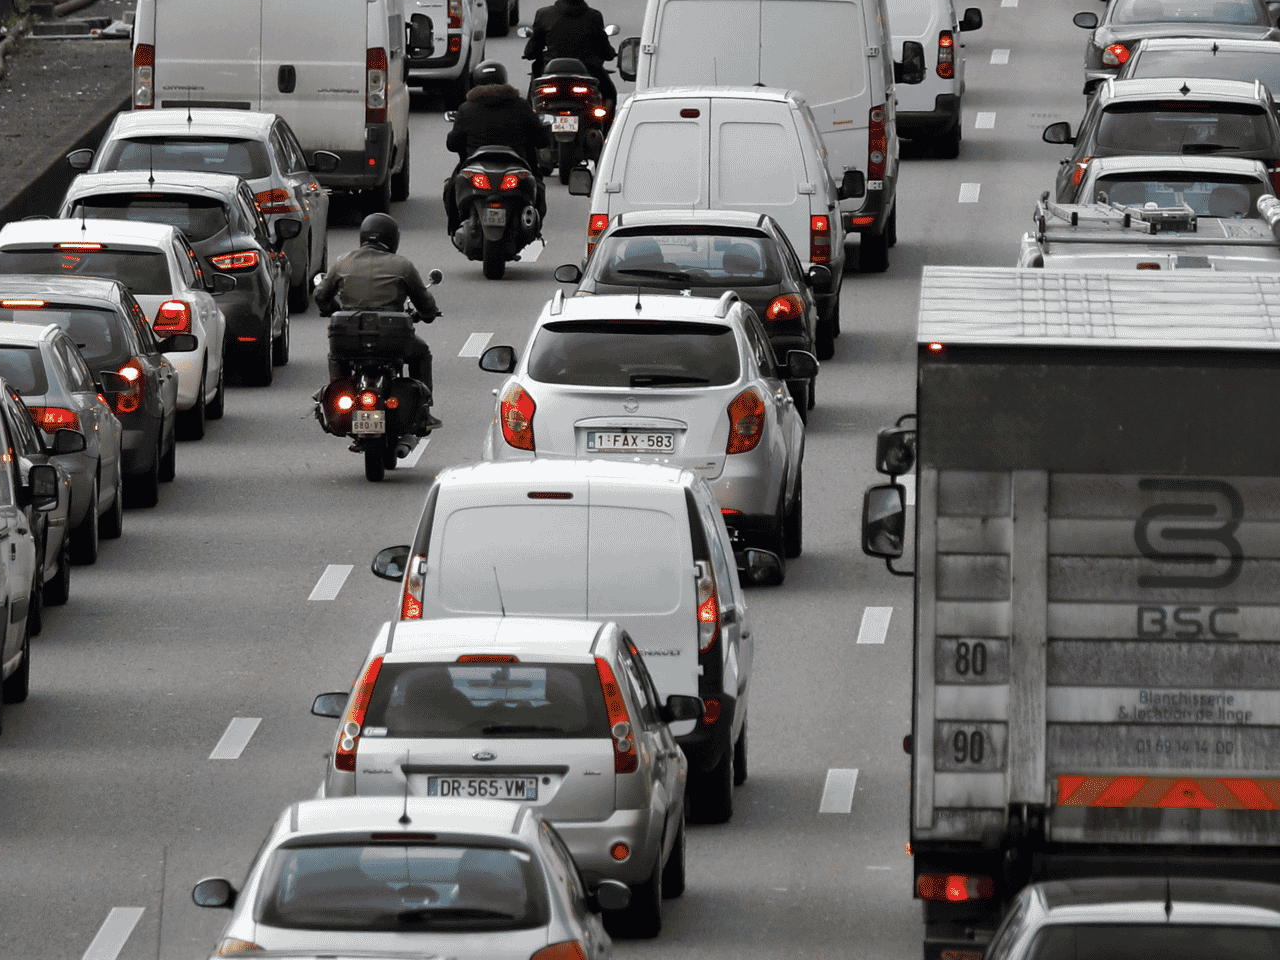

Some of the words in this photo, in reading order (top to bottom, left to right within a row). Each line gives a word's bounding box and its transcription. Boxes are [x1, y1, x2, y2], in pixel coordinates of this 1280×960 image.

[1136, 606, 1241, 639] BSC
[955, 640, 987, 677] 80
[1138, 690, 1235, 705] Blanchisserie
[1133, 706, 1192, 721] location
[1195, 707, 1213, 721] de
[1218, 707, 1253, 725] linge
[953, 729, 985, 764] 90
[441, 779, 525, 797] DR-565-VM
